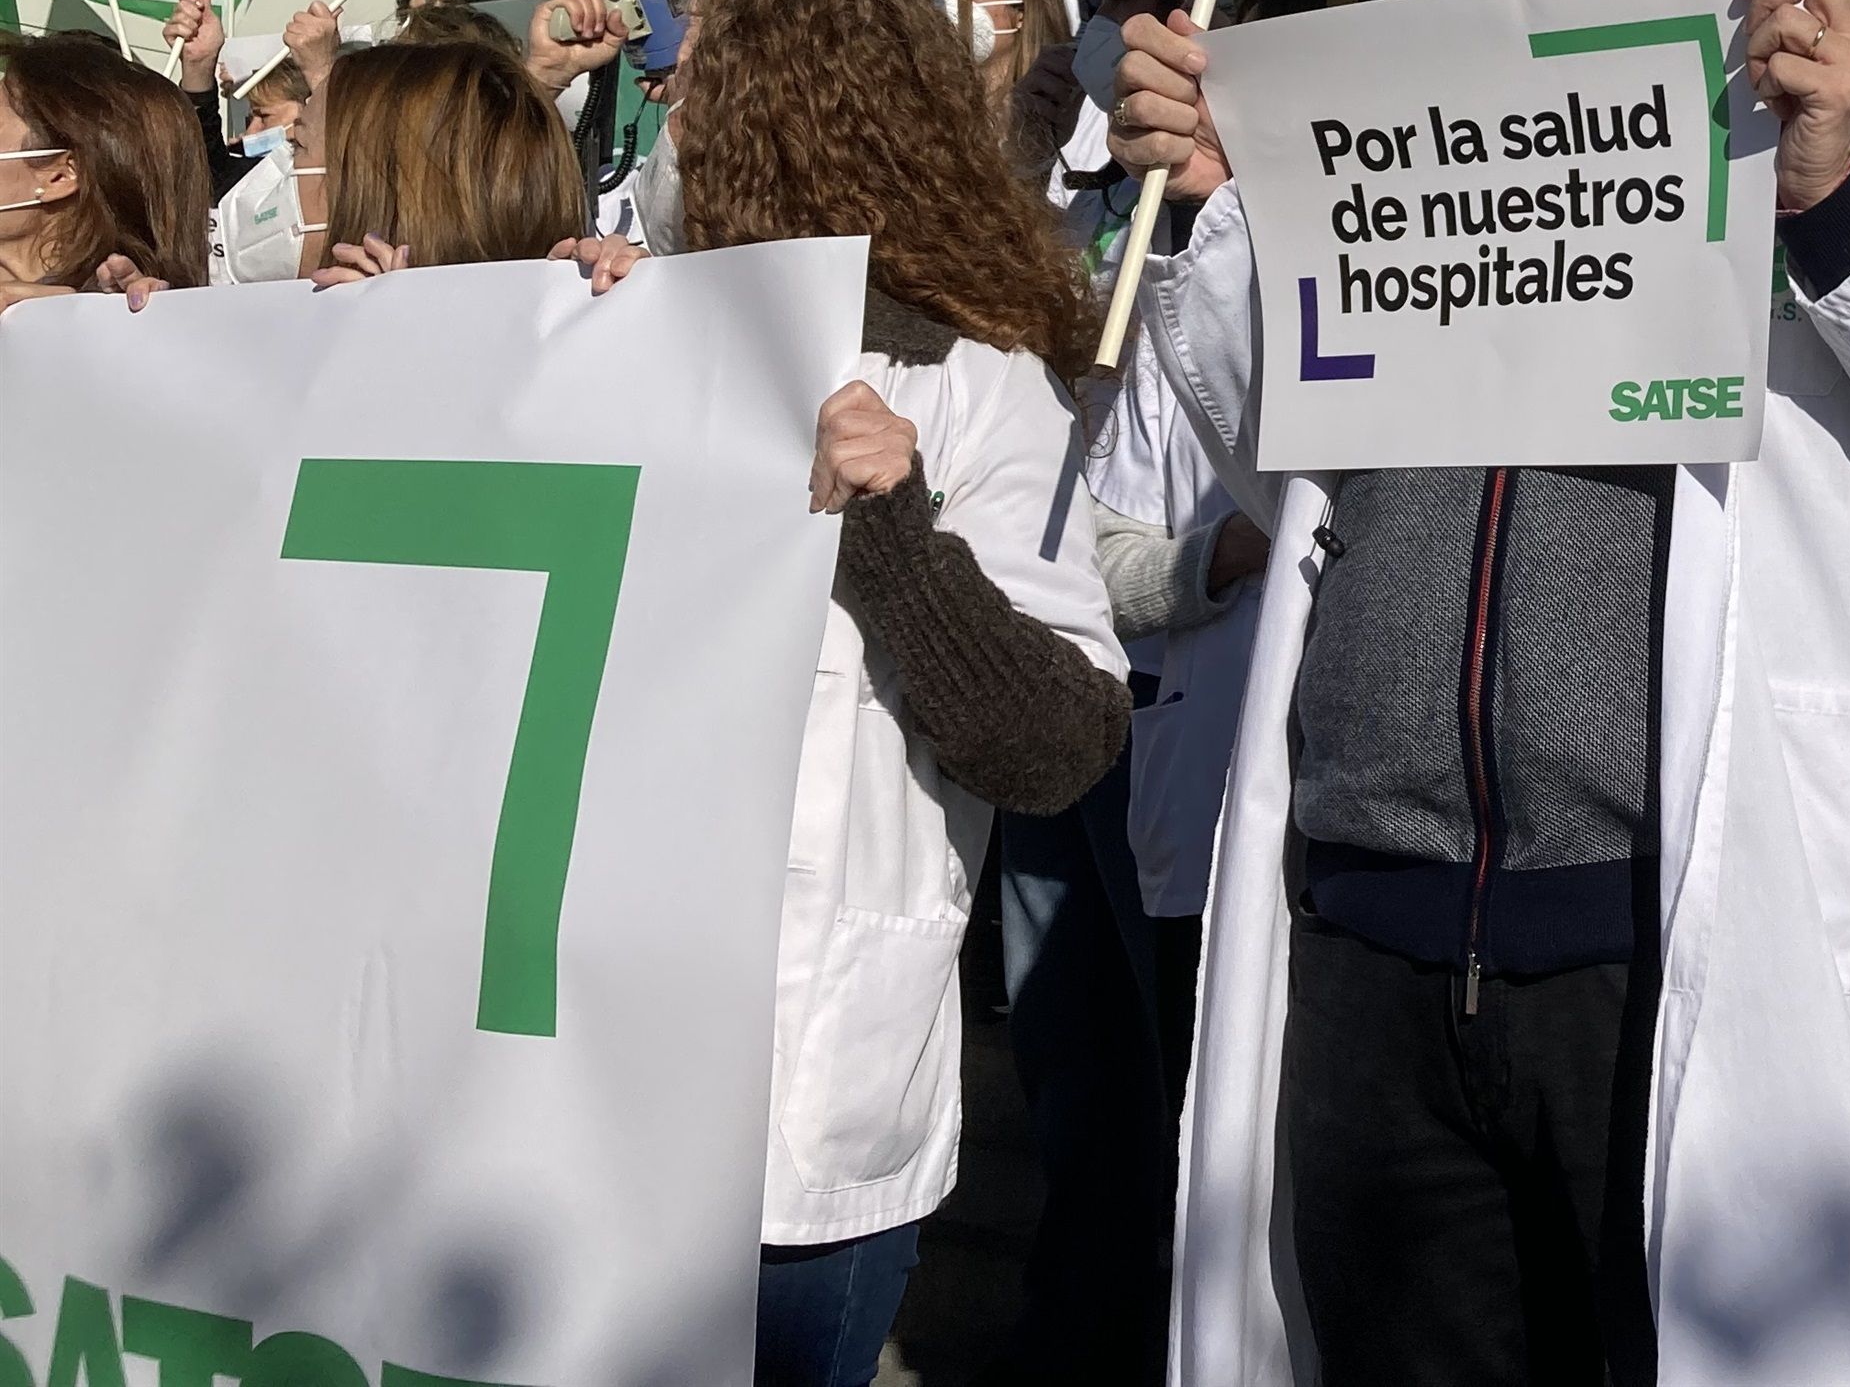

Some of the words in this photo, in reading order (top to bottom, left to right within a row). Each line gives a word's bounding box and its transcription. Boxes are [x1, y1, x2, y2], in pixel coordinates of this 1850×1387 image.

[1310, 117, 1418, 176] Por
[1427, 105, 1489, 166] la
[1499, 83, 1673, 160] salud
[1330, 182, 1408, 244] de
[1420, 168, 1685, 239] nuestros
[1338, 239, 1635, 327] hospitales
[1607, 375, 1746, 424] SATSE
